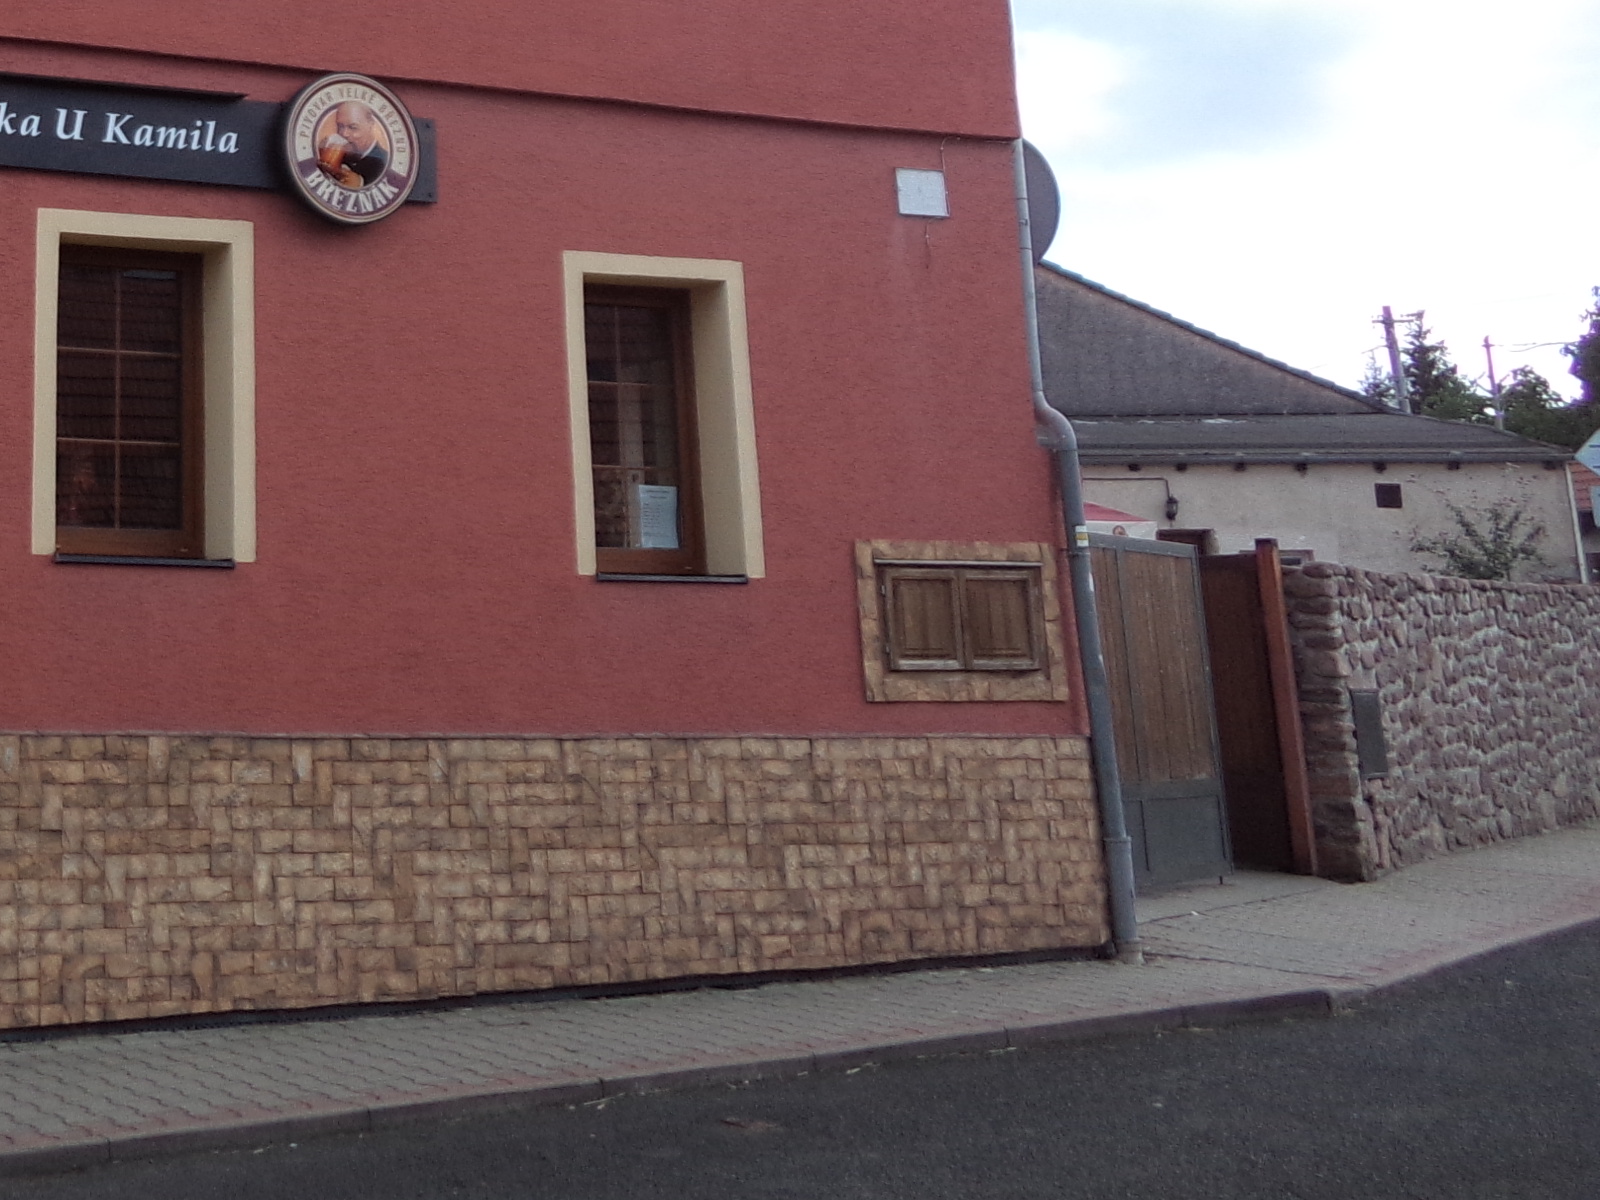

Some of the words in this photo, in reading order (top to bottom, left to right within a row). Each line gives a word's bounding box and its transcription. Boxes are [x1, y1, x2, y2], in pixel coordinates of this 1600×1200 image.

[55, 108, 88, 141] U
[102, 112, 240, 154] Kamila
[300, 91, 334, 138] PIVOVAR
